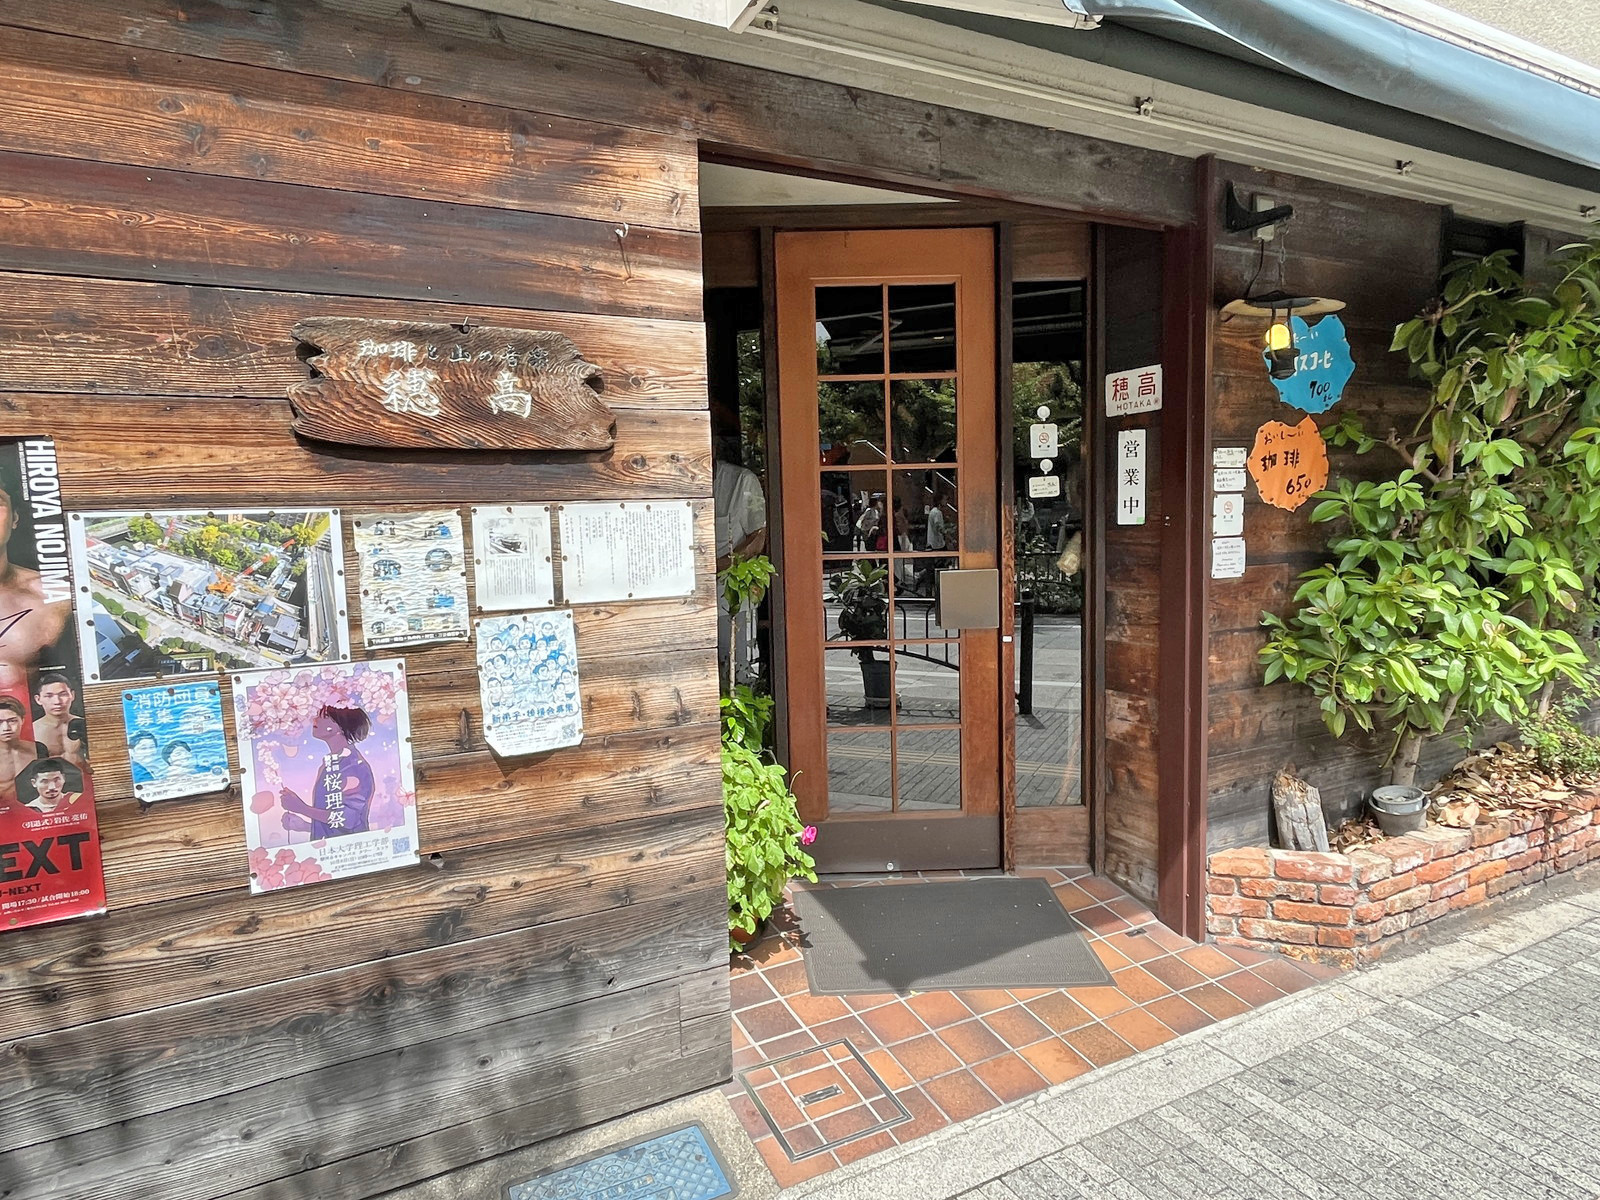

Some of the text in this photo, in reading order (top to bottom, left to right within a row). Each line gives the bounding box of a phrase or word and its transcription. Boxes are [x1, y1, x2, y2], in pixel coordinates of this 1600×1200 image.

[1112, 372, 1157, 402] 穂高
[1309, 380, 1331, 399] 700
[1116, 399, 1152, 412] HOTAKA
[1260, 448, 1300, 472] 珈琲
[1123, 440, 1140, 514] 営業中
[1286, 473, 1312, 495] 650
[25, 441, 72, 605] HIROYA NOJIMA
[133, 686, 210, 710] 消防団員
[323, 773, 346, 829] 桜理祭
[319, 837, 389, 856] 日本大学理工学部
